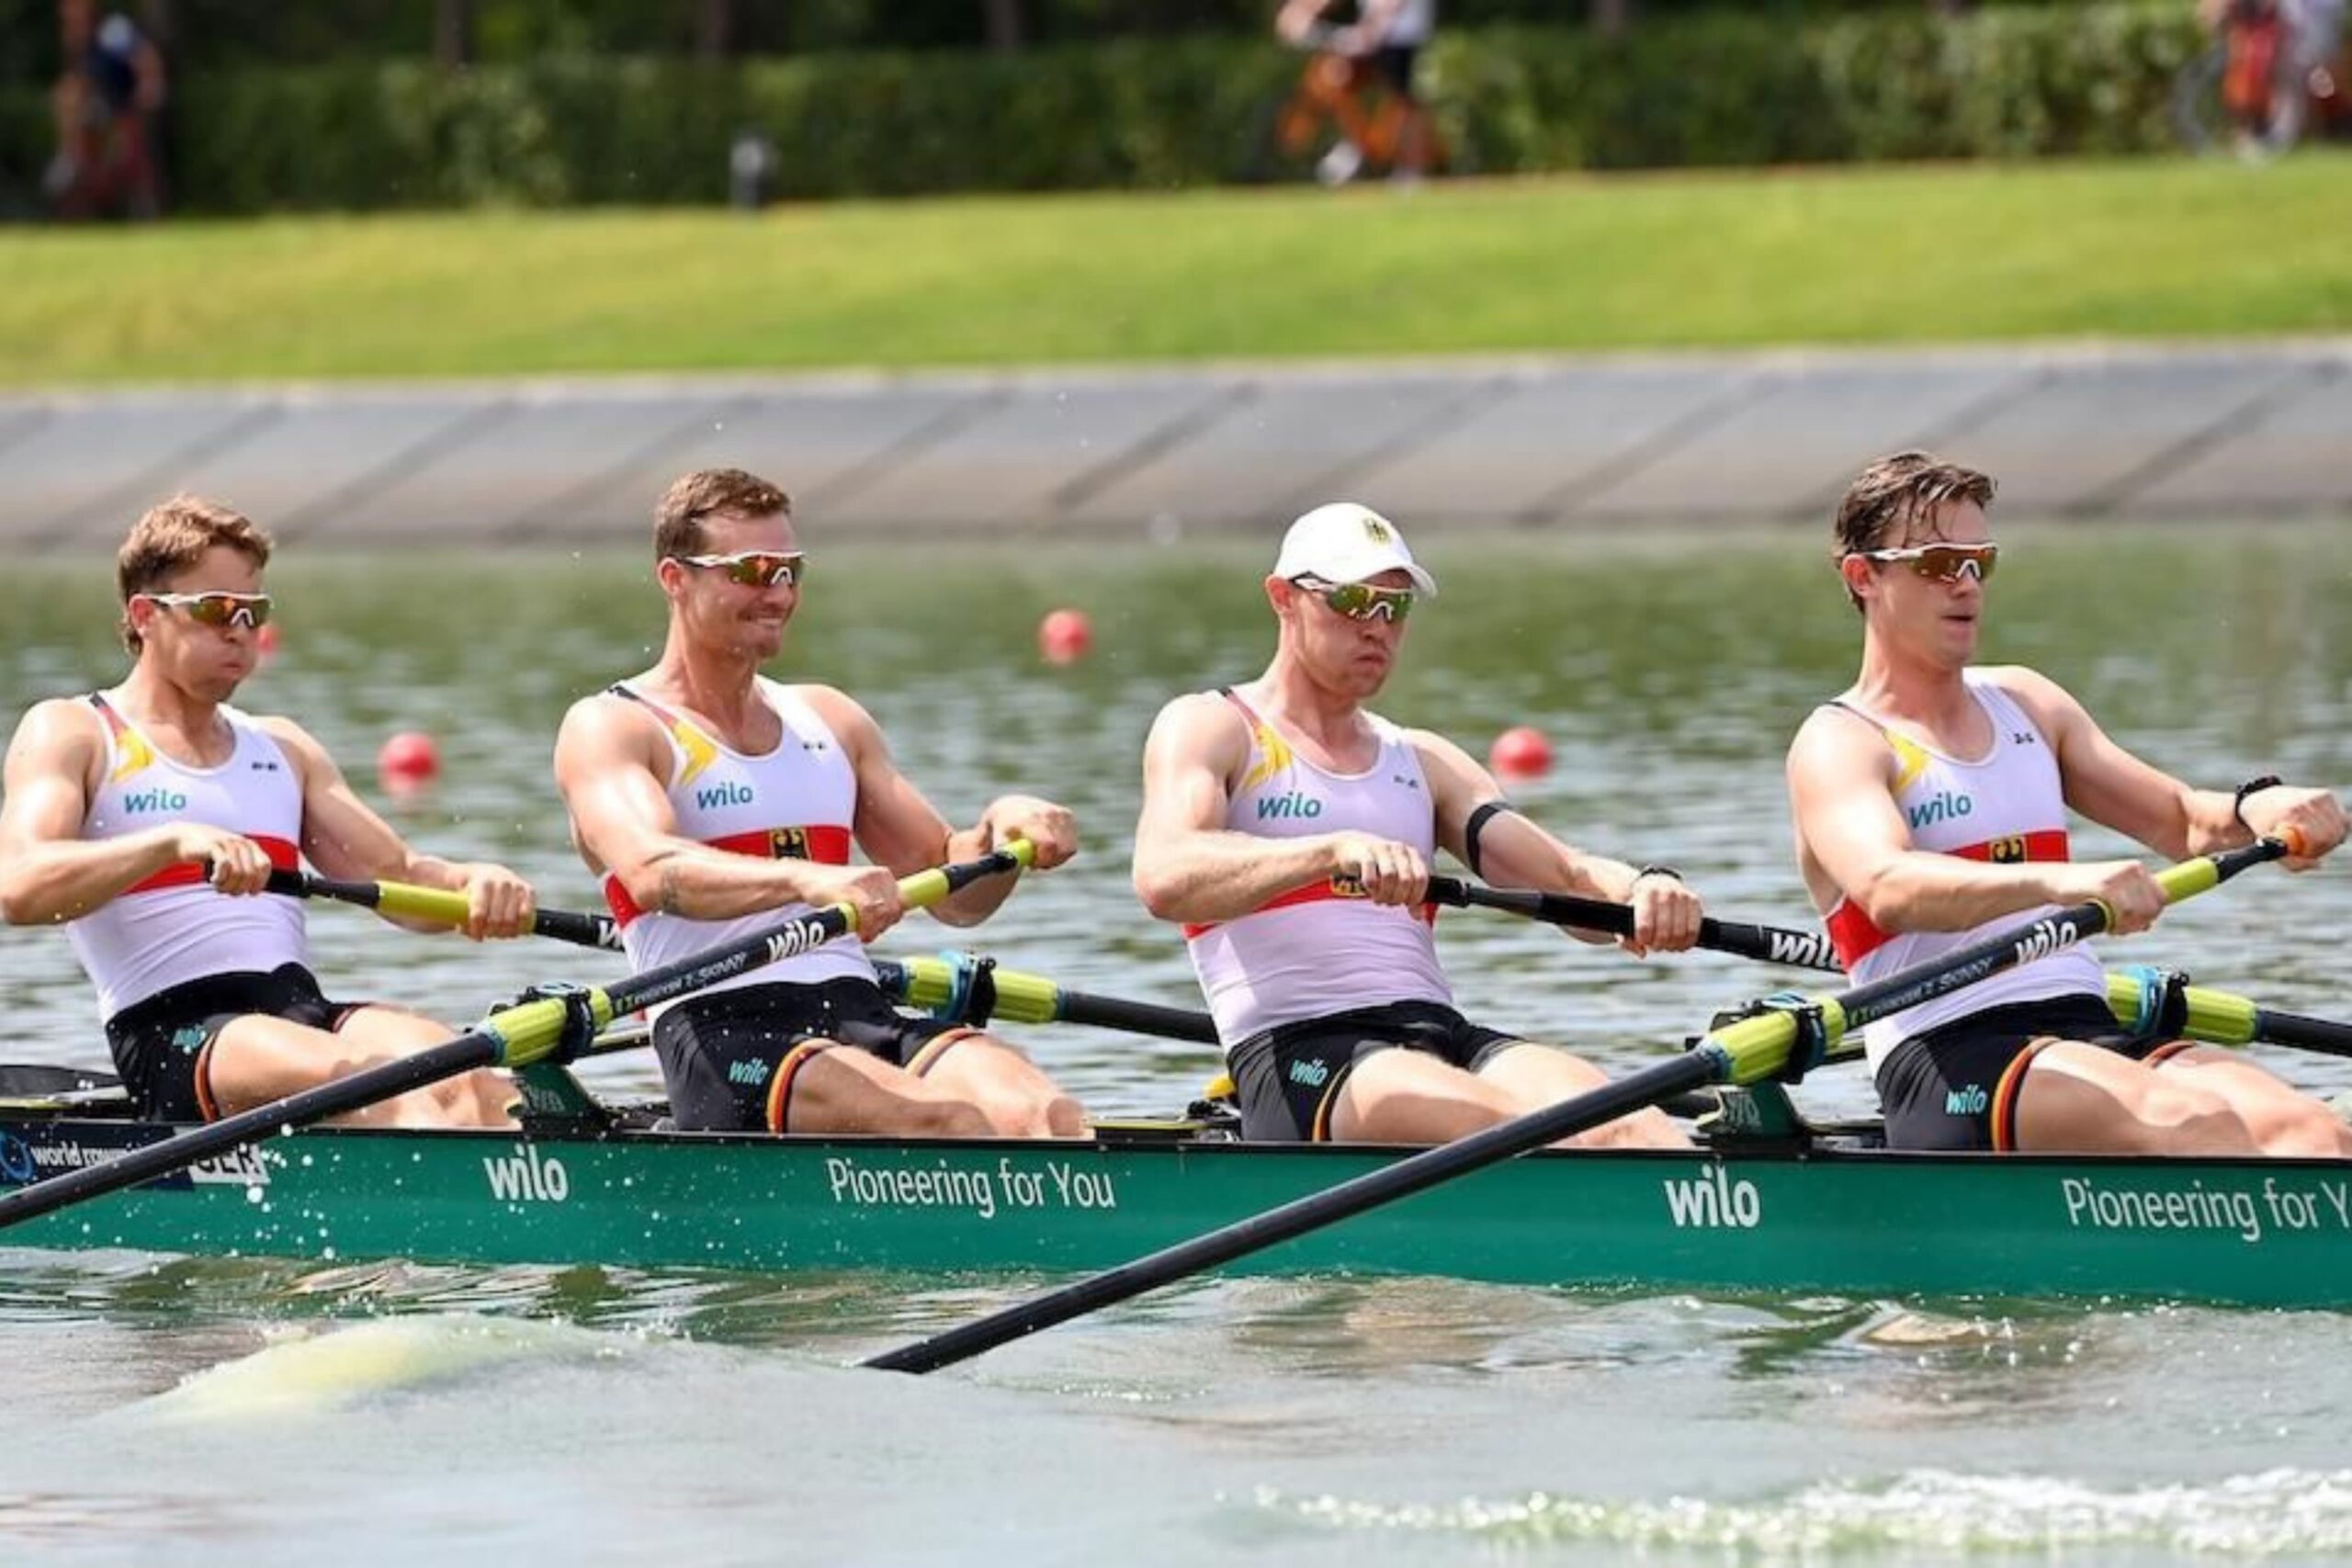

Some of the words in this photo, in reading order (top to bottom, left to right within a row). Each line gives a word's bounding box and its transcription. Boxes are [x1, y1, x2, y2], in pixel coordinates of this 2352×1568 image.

[124, 788, 187, 814] wilo
[698, 781, 753, 811] wilo
[1257, 791, 1322, 821] wilo
[1909, 791, 1972, 829] wilo
[766, 919, 825, 962] wilo
[2015, 918, 2077, 963] wilo
[1945, 1084, 1988, 1114] wilo
[30, 1140, 84, 1166] world
[482, 1144, 569, 1201] wilo
[827, 1157, 995, 1218] Pioneering
[998, 1157, 1045, 1206] for
[1047, 1161, 1116, 1208] You
[1664, 1164, 1760, 1228] wilo
[2062, 1178, 2261, 1242] Pioneering
[2263, 1178, 2320, 1228] for
[2320, 1181, 2352, 1228] Y
